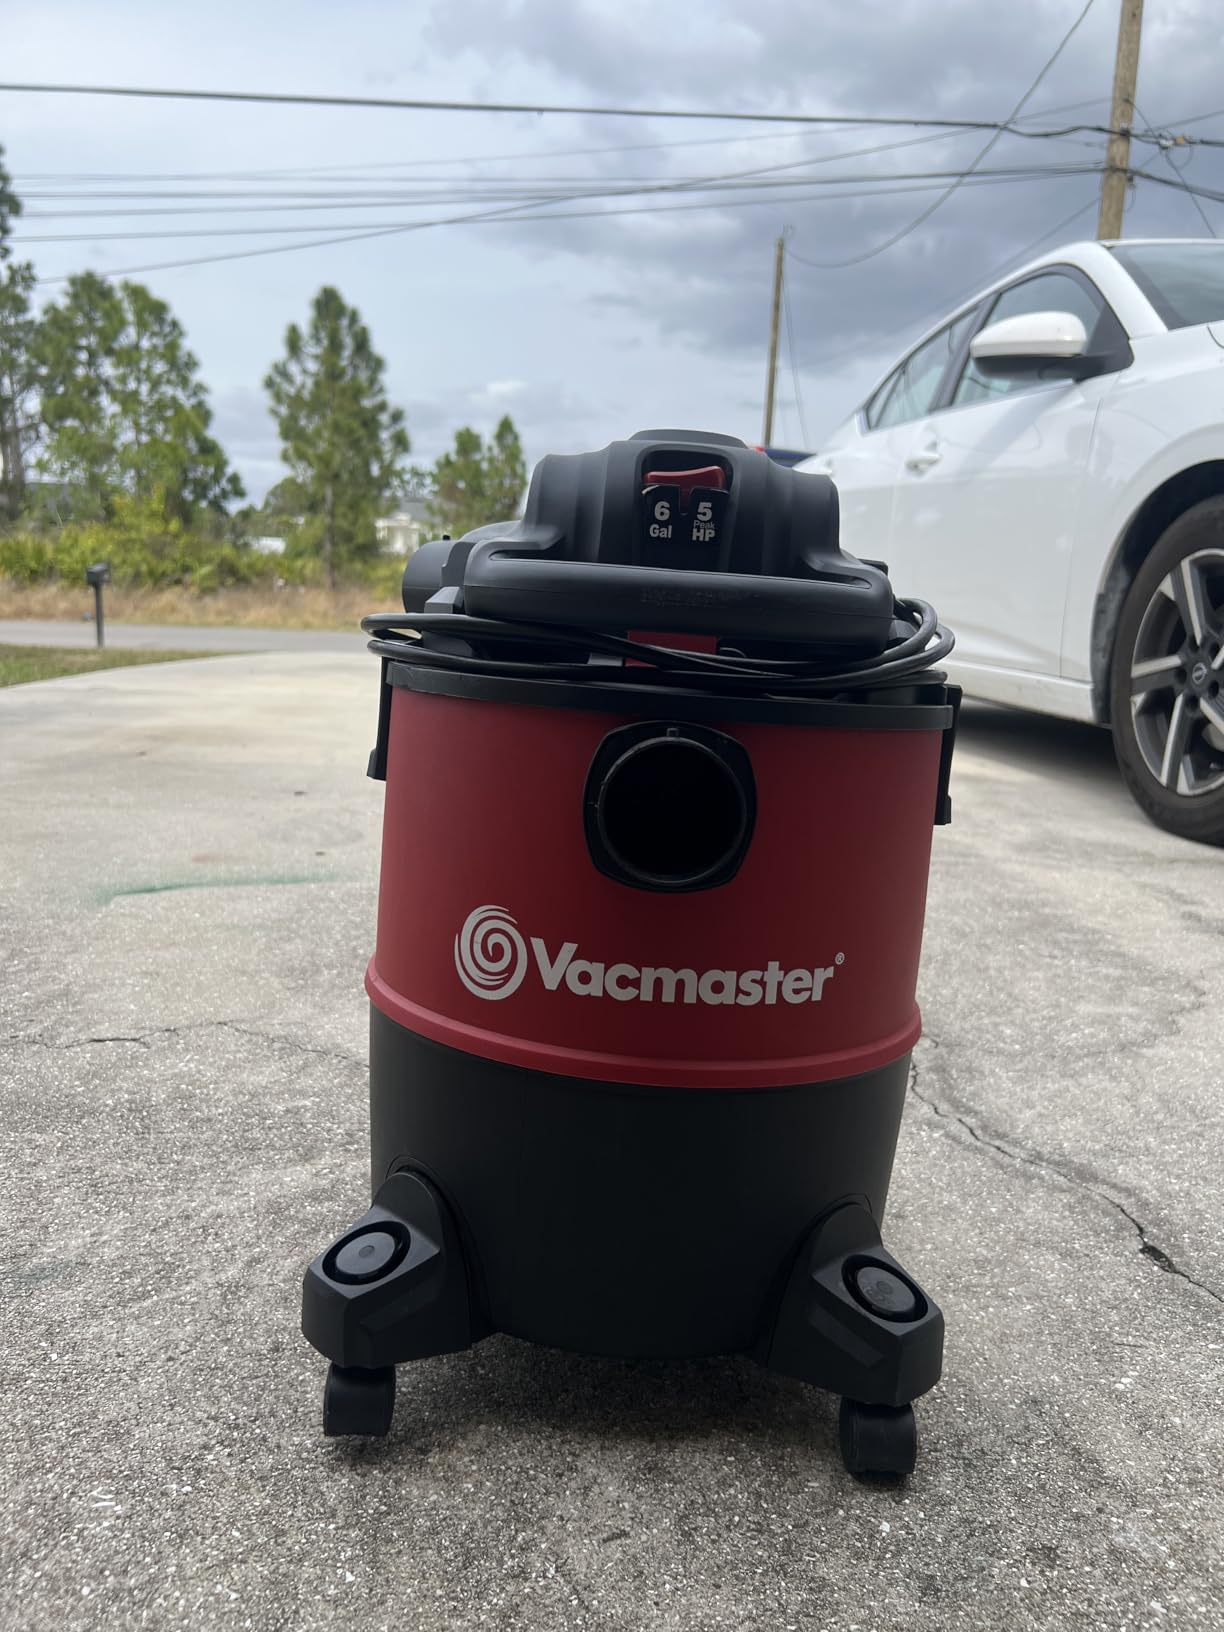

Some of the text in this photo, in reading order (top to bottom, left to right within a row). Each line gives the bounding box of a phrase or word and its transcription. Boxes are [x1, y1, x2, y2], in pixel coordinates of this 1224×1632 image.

[654, 501, 670, 521] 6
[696, 502, 712, 521] 5
[649, 524, 672, 538] Gal
[693, 520, 715, 529] Peak
[692, 528, 715, 541] HP
